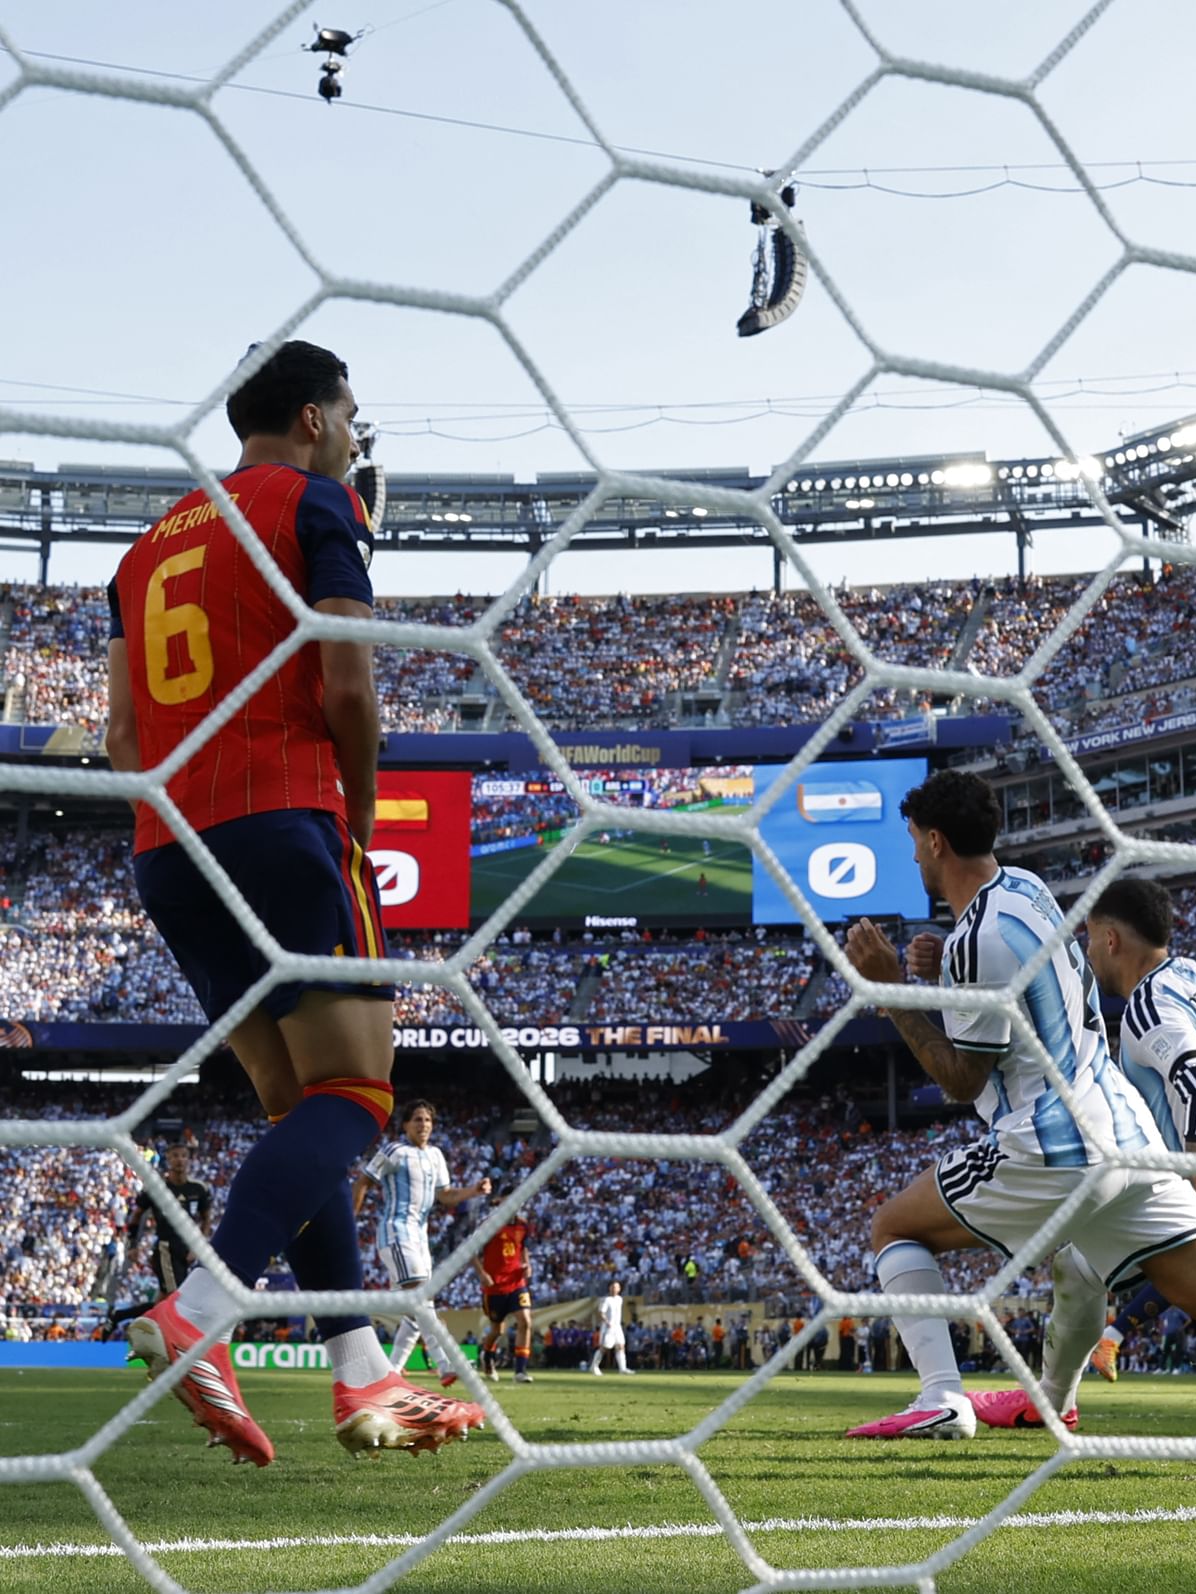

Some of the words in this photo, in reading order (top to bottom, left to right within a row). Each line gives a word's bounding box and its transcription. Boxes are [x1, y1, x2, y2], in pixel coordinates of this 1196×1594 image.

[152, 493, 240, 543] MERIN
[144, 544, 214, 705] 6
[1082, 731, 1121, 750] YORK
[1122, 723, 1156, 741] NEW
[539, 744, 661, 766] IFAWorldCup
[364, 849, 419, 907] 0
[808, 842, 877, 899] 0
[585, 915, 637, 928] Hisense
[392, 1028, 448, 1048] ORLD
[502, 1027, 581, 1047] 2026
[586, 1026, 642, 1045] THE
[646, 1025, 730, 1045] FINAL
[234, 1343, 332, 1369] aram
